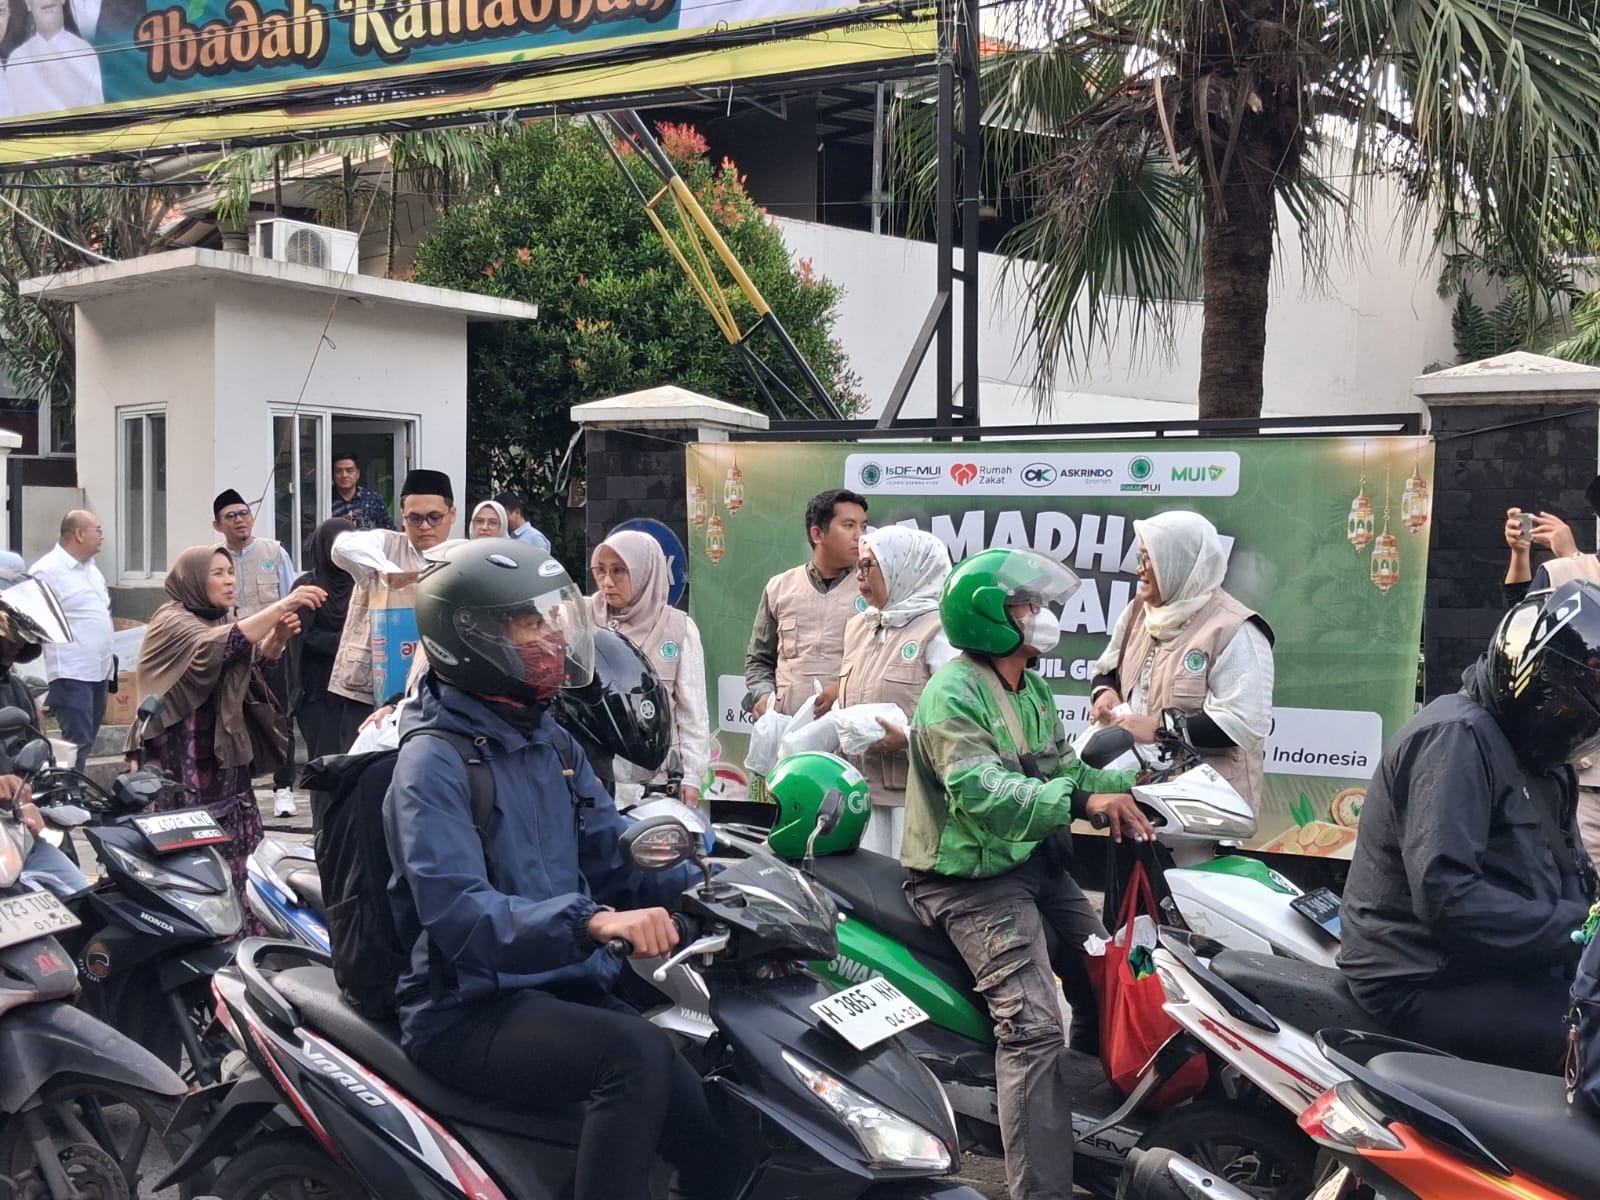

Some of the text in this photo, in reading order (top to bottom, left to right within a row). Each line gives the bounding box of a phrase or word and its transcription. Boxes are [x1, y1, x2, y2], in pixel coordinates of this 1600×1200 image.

[138, 0, 323, 74] Ibadah
[979, 465, 1012, 474] Rumah
[1060, 469, 1114, 478] ASKRINDO
[1171, 466, 1206, 482] MUI
[979, 476, 1006, 485] Zakat
[725, 708, 735, 722] &
[1273, 746, 1368, 768] Indonesia
[141, 911, 174, 933] HONDA
[680, 1007, 714, 1025] YAMAHA
[818, 1004, 843, 1025] H
[834, 989, 877, 1017] 3865
[302, 1040, 388, 1107] VARIO
